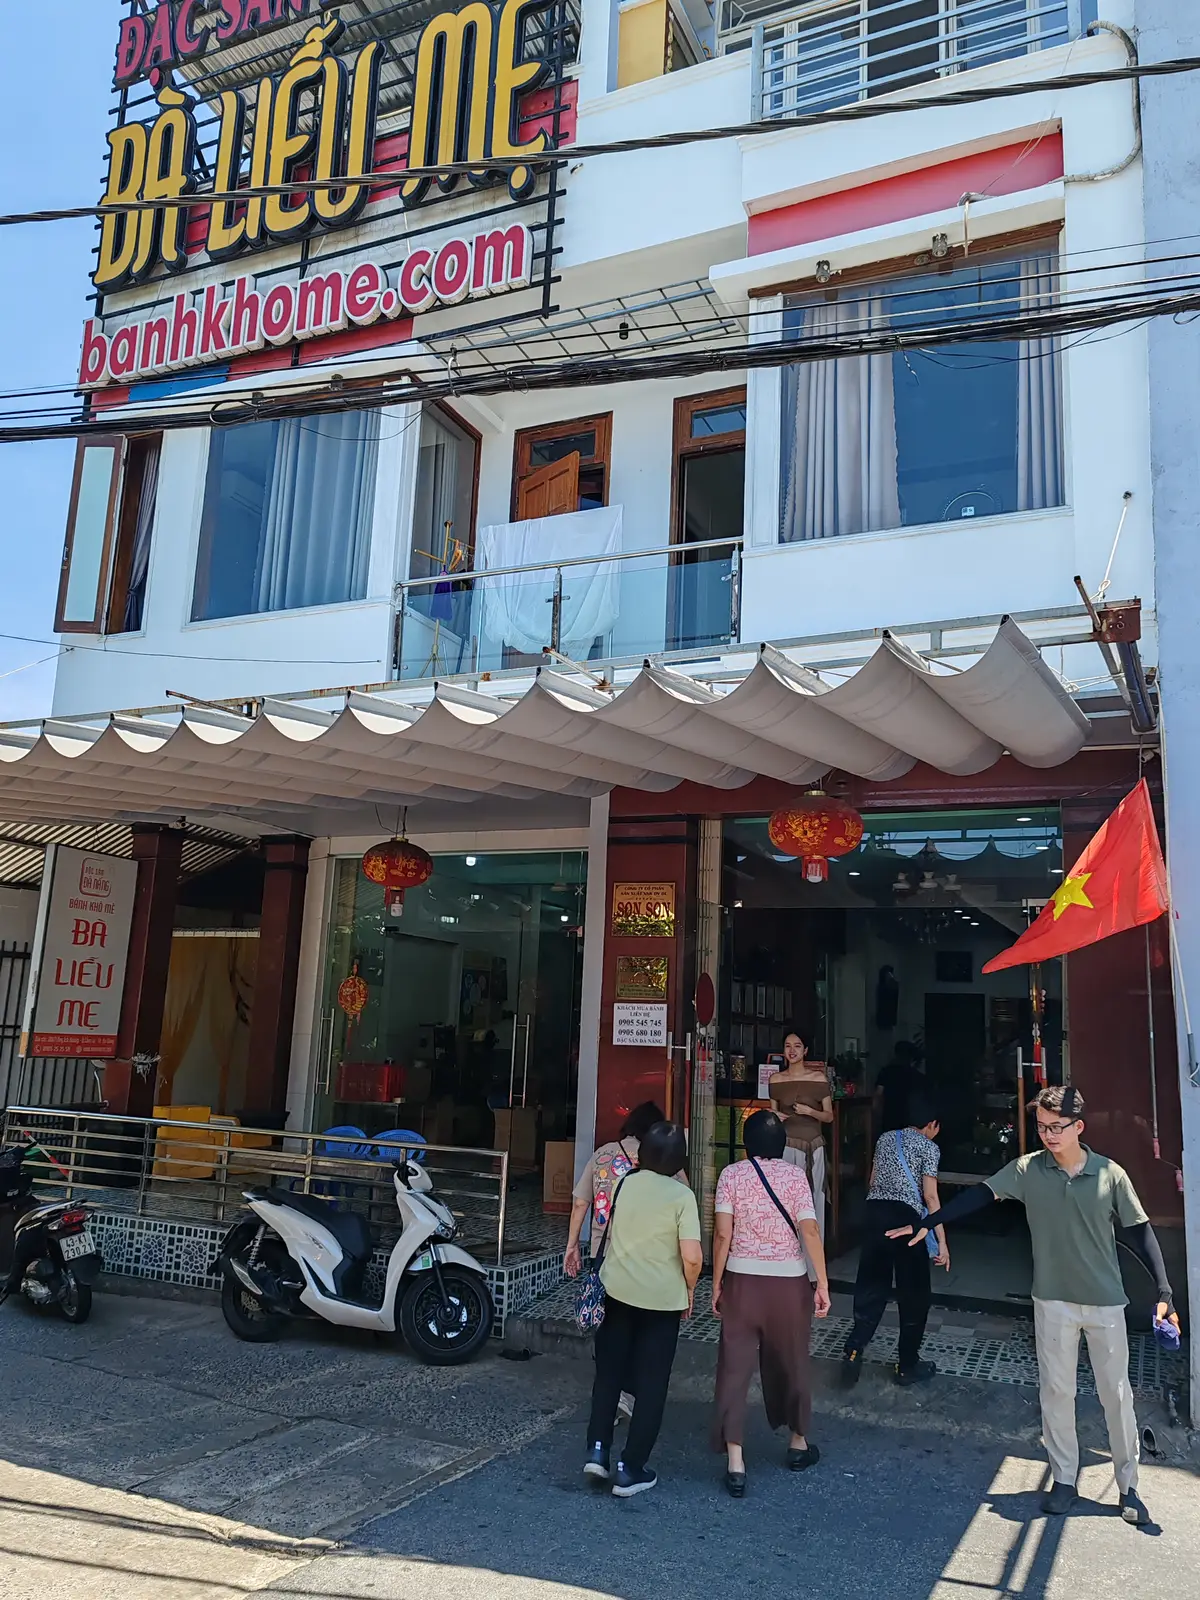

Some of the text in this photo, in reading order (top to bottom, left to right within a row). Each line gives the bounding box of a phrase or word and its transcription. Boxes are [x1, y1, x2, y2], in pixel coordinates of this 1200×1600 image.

[93, 86, 189, 285] BÀ
[402, 0, 545, 189] MẸ
[80, 223, 528, 386] banhkhome.com
[69, 898, 88, 910] BÁNH
[71, 918, 108, 948] BÀ
[54, 957, 116, 988] LIỄU
[56, 999, 101, 1031] MẸ
[635, 1019, 648, 1027] 545
[650, 1019, 662, 1027] 745
[618, 1028, 662, 1037] 0905 680 180
[65, 1234, 87, 1248] 43-K1
[65, 1243, 93, 1259] 230.21
